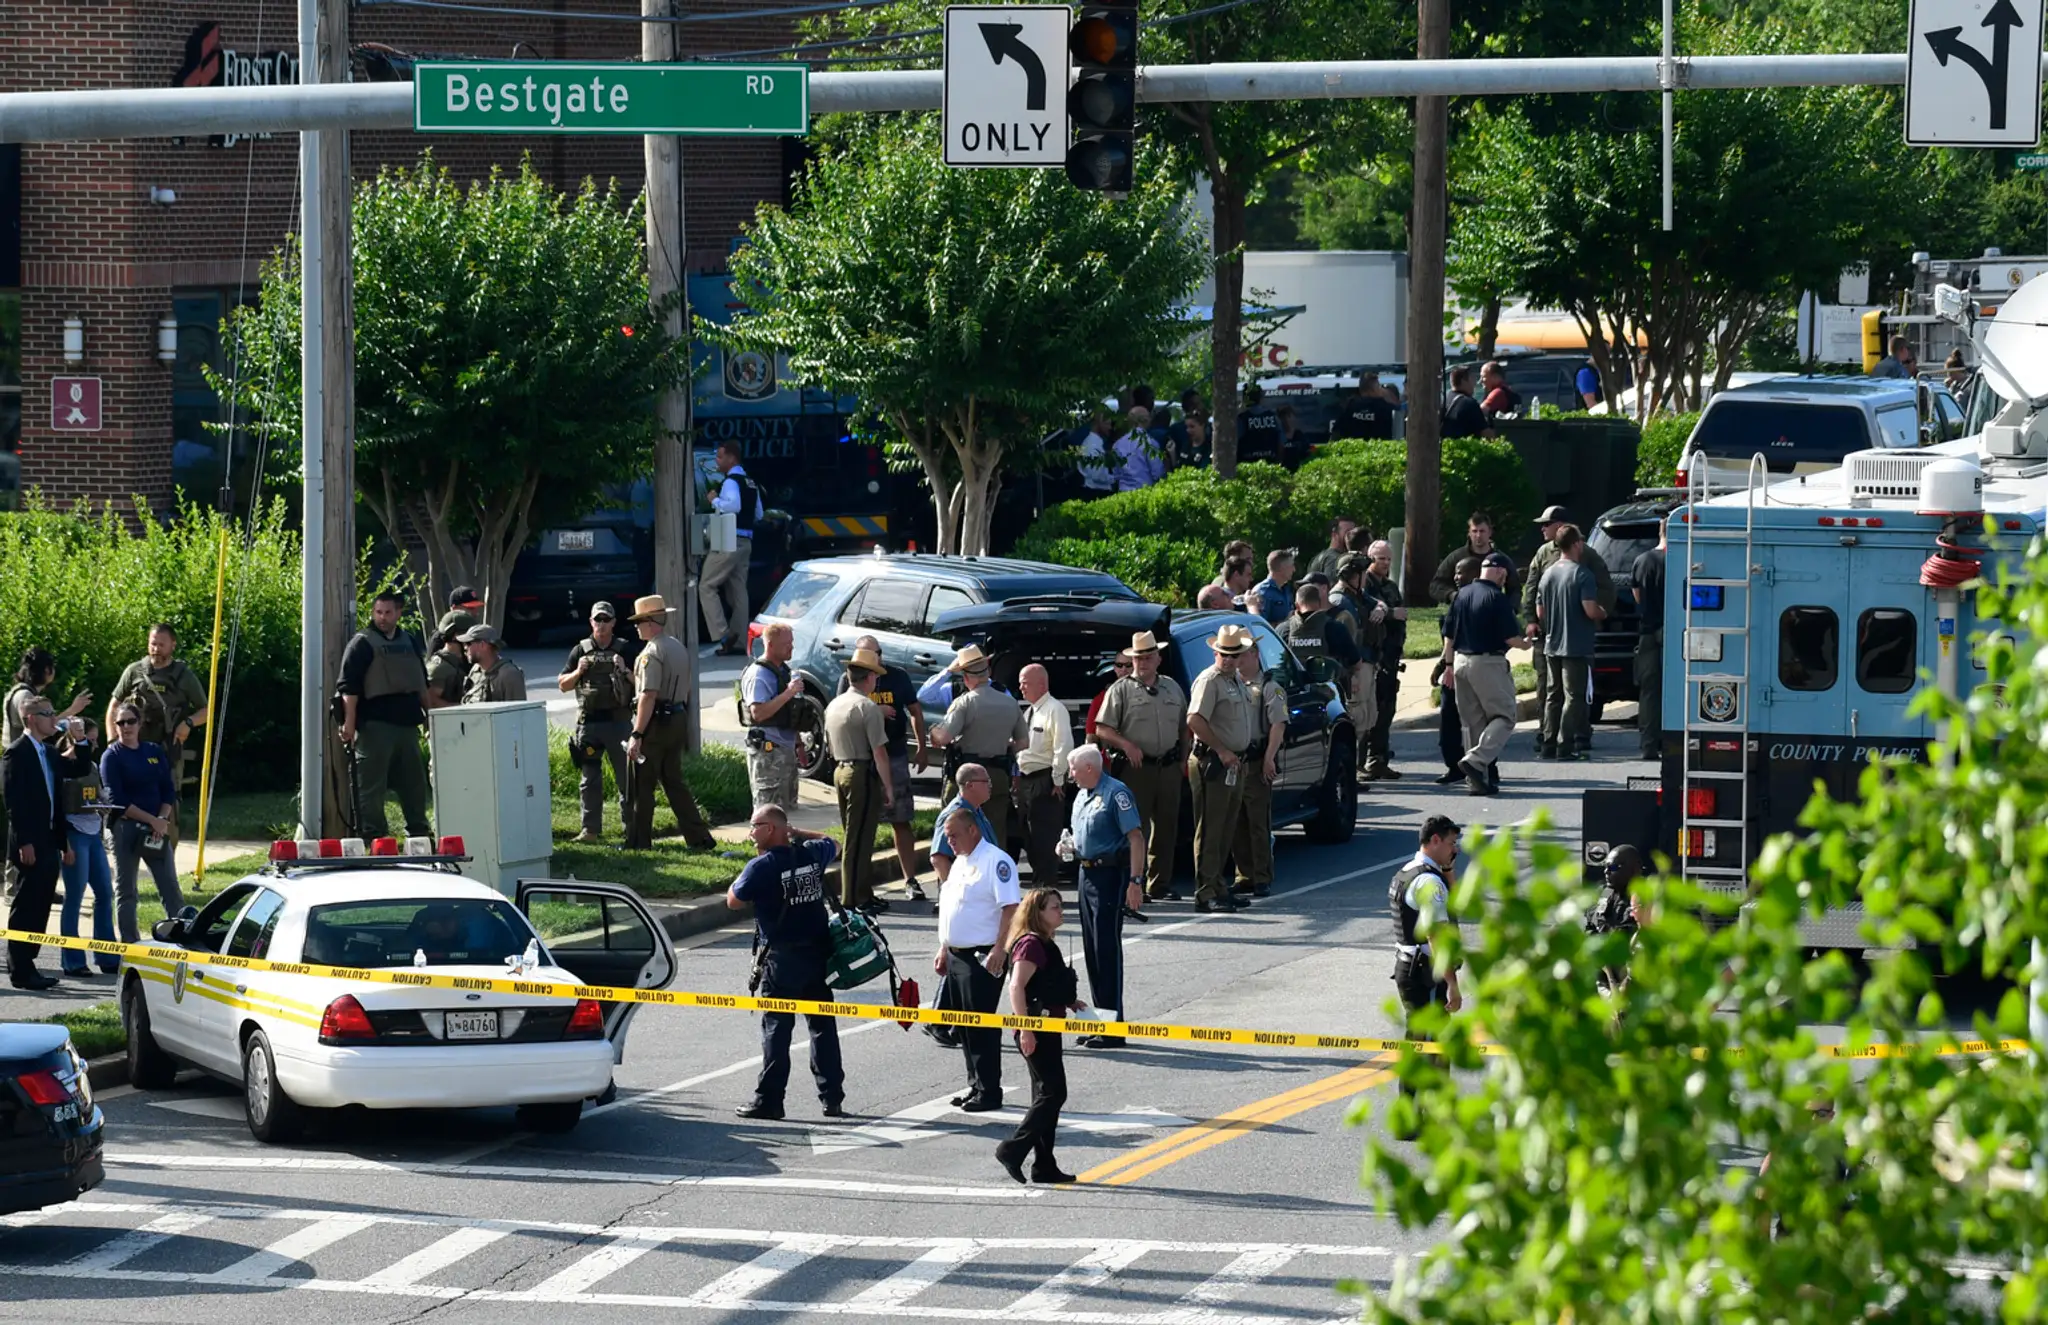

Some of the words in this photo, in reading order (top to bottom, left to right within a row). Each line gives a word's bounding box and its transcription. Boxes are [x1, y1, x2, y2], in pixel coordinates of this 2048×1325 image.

[446, 74, 629, 124] Bestgate
[746, 76, 775, 95] RD
[962, 122, 1051, 152] ONLY
[703, 417, 798, 439] COUNTY
[1248, 415, 1276, 429] POLICE
[1291, 638, 1322, 647] TROOPER
[1768, 743, 1846, 761] COUNTY
[82, 786, 97, 801] FBI
[27, 934, 66, 945] CAUTION
[87, 941, 127, 953] CAUTION
[147, 948, 188, 960] CAUTION
[209, 955, 248, 967] CAUTION
[271, 962, 310, 973] CAUTION
[332, 968, 370, 980] CAUTION
[392, 973, 431, 985] CAUTION
[452, 978, 492, 990] CAUTION
[513, 982, 552, 995] CAUTION
[574, 987, 612, 999] CAUTION
[635, 991, 674, 1003] CAUTION
[696, 995, 735, 1007] CAUTION
[757, 999, 796, 1011] CAUTION
[818, 1003, 857, 1015] CAUTION
[879, 1008, 918, 1020] CAUTION
[941, 1012, 980, 1025] CAUTION
[1002, 1016, 1042, 1029] CAUTION
[462, 1018, 496, 1032] 84760
[1064, 1021, 1105, 1033] CAUTION
[1127, 1024, 1168, 1037] CAUTION
[1190, 1029, 1231, 1041] CAUTION
[1254, 1033, 1295, 1045] CAUTION
[1317, 1037, 1359, 1048] CAUTION
